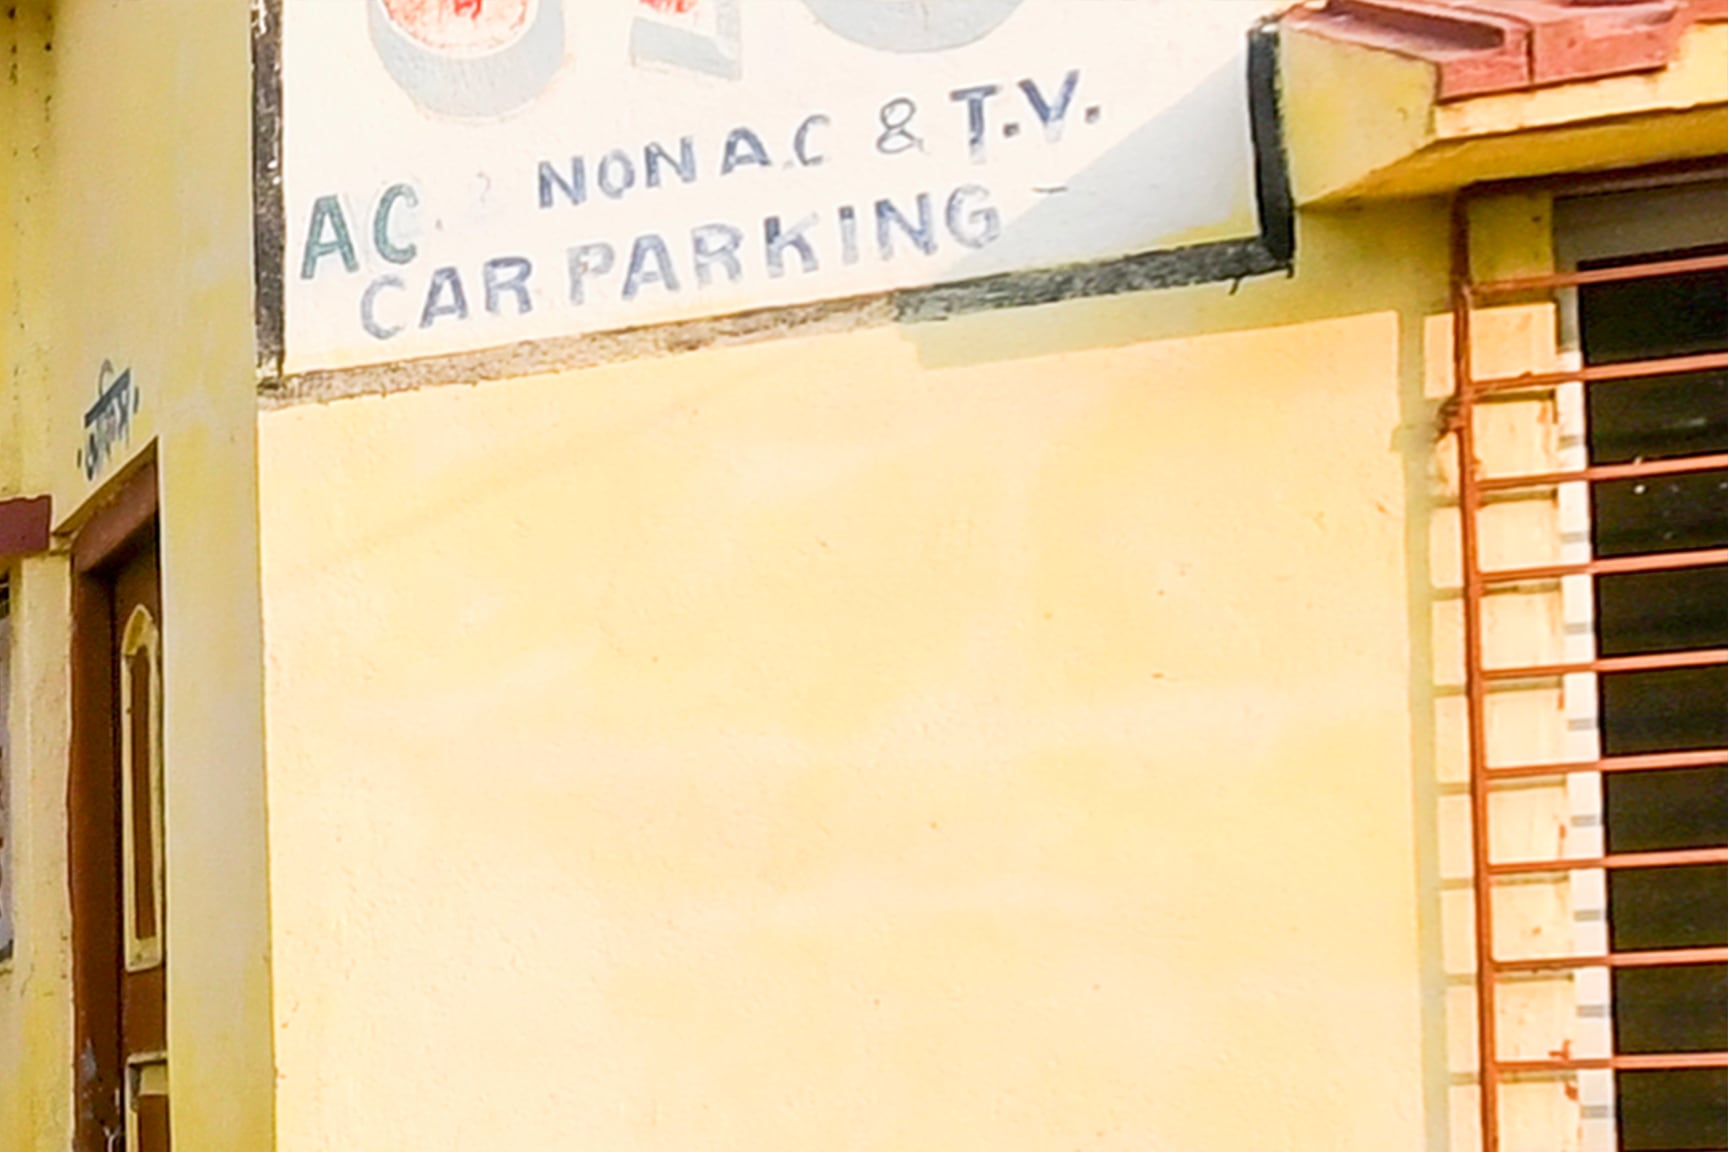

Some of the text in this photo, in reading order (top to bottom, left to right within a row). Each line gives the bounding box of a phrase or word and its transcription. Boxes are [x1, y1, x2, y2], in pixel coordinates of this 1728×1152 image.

[300, 182, 420, 280] AC
[875, 97, 930, 155] &
[948, 68, 1102, 163] T.V.
[359, 184, 1003, 341] CAR PARKING
